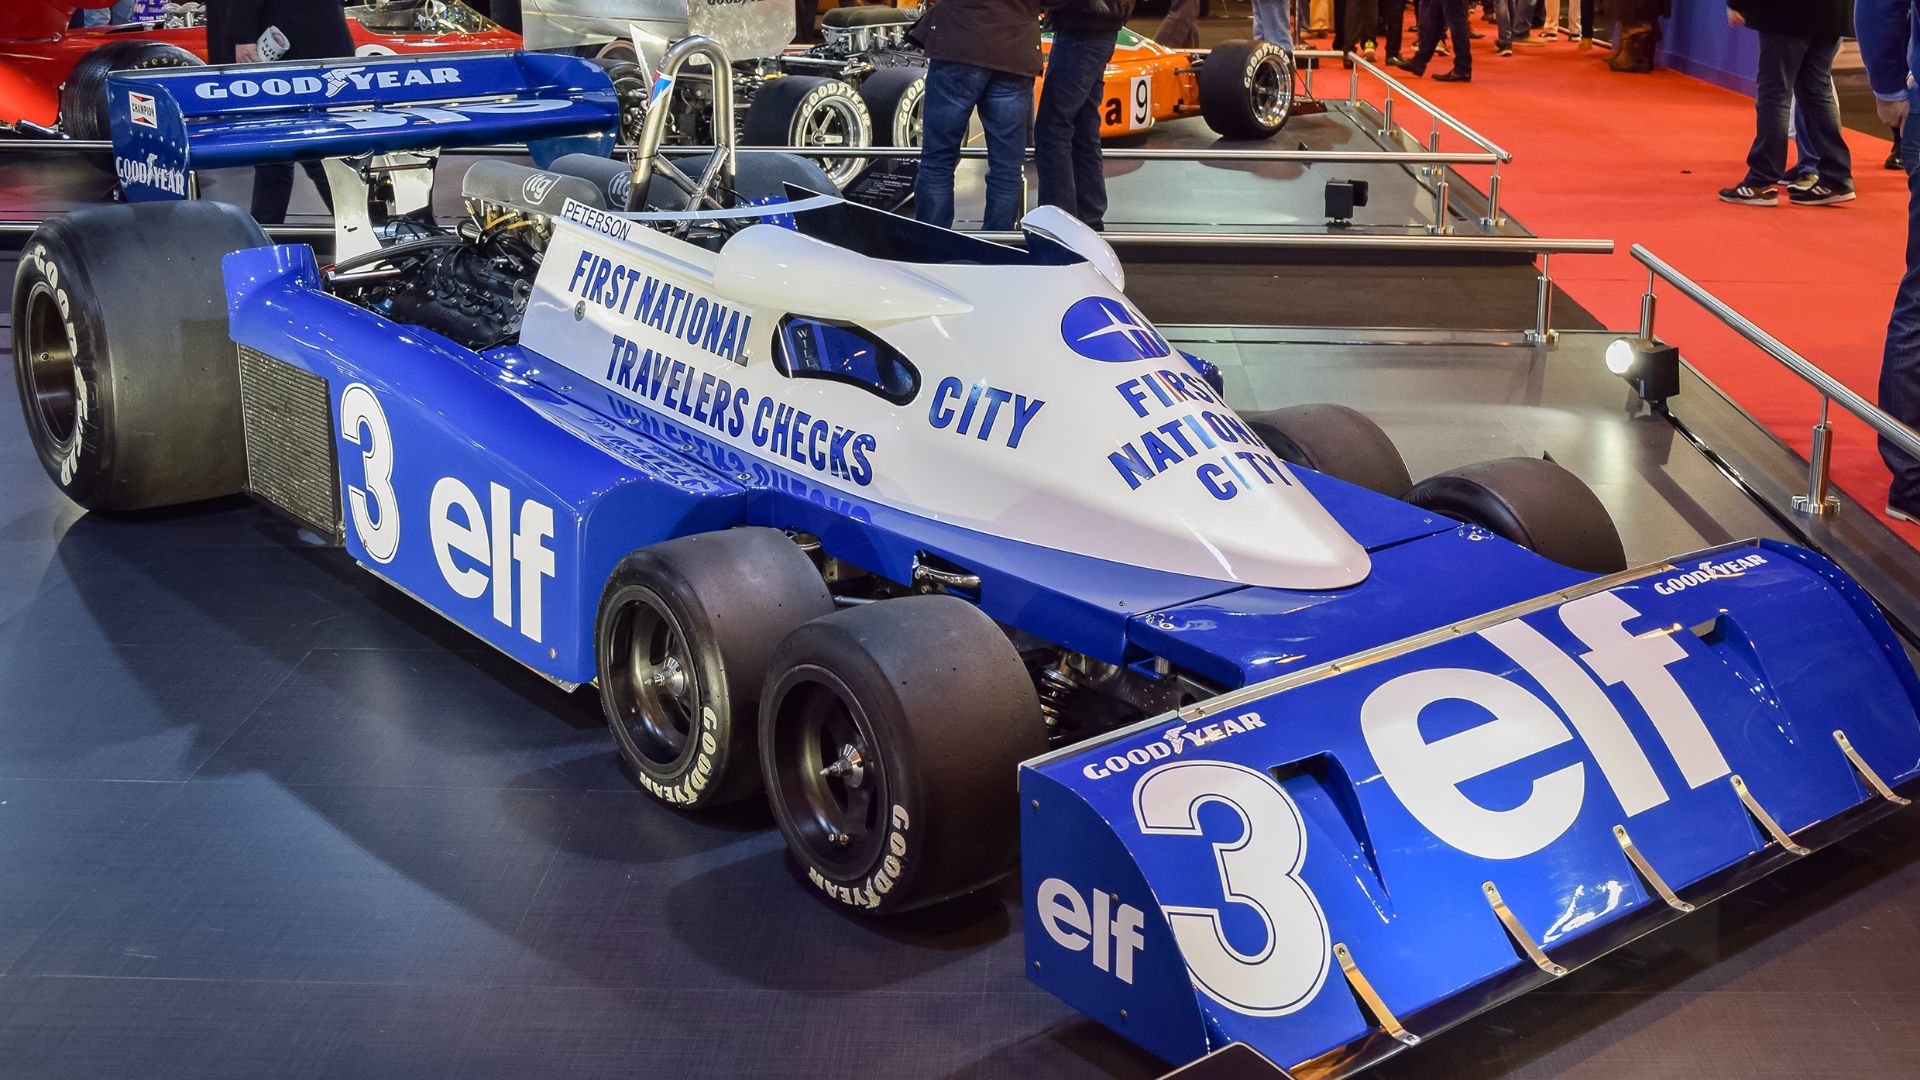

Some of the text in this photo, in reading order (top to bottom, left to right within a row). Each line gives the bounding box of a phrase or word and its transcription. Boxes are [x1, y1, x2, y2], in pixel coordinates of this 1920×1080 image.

[131, 102, 155, 118] CHAMPION
[1135, 79, 1148, 125] 9
[563, 201, 632, 241] PETERSON
[568, 250, 752, 368] FIRST NATIONAL
[606, 334, 749, 438] TRAVELERS
[752, 396, 877, 487] CHECKS
[928, 376, 1046, 449] CITY
[1115, 369, 1228, 419] FIRST
[340, 382, 400, 564] 3
[429, 476, 555, 644] elf
[1196, 451, 1293, 501] CITY
[1360, 590, 1731, 860] elf
[1037, 877, 1145, 985] elf
[1133, 759, 1332, 1018] 3
